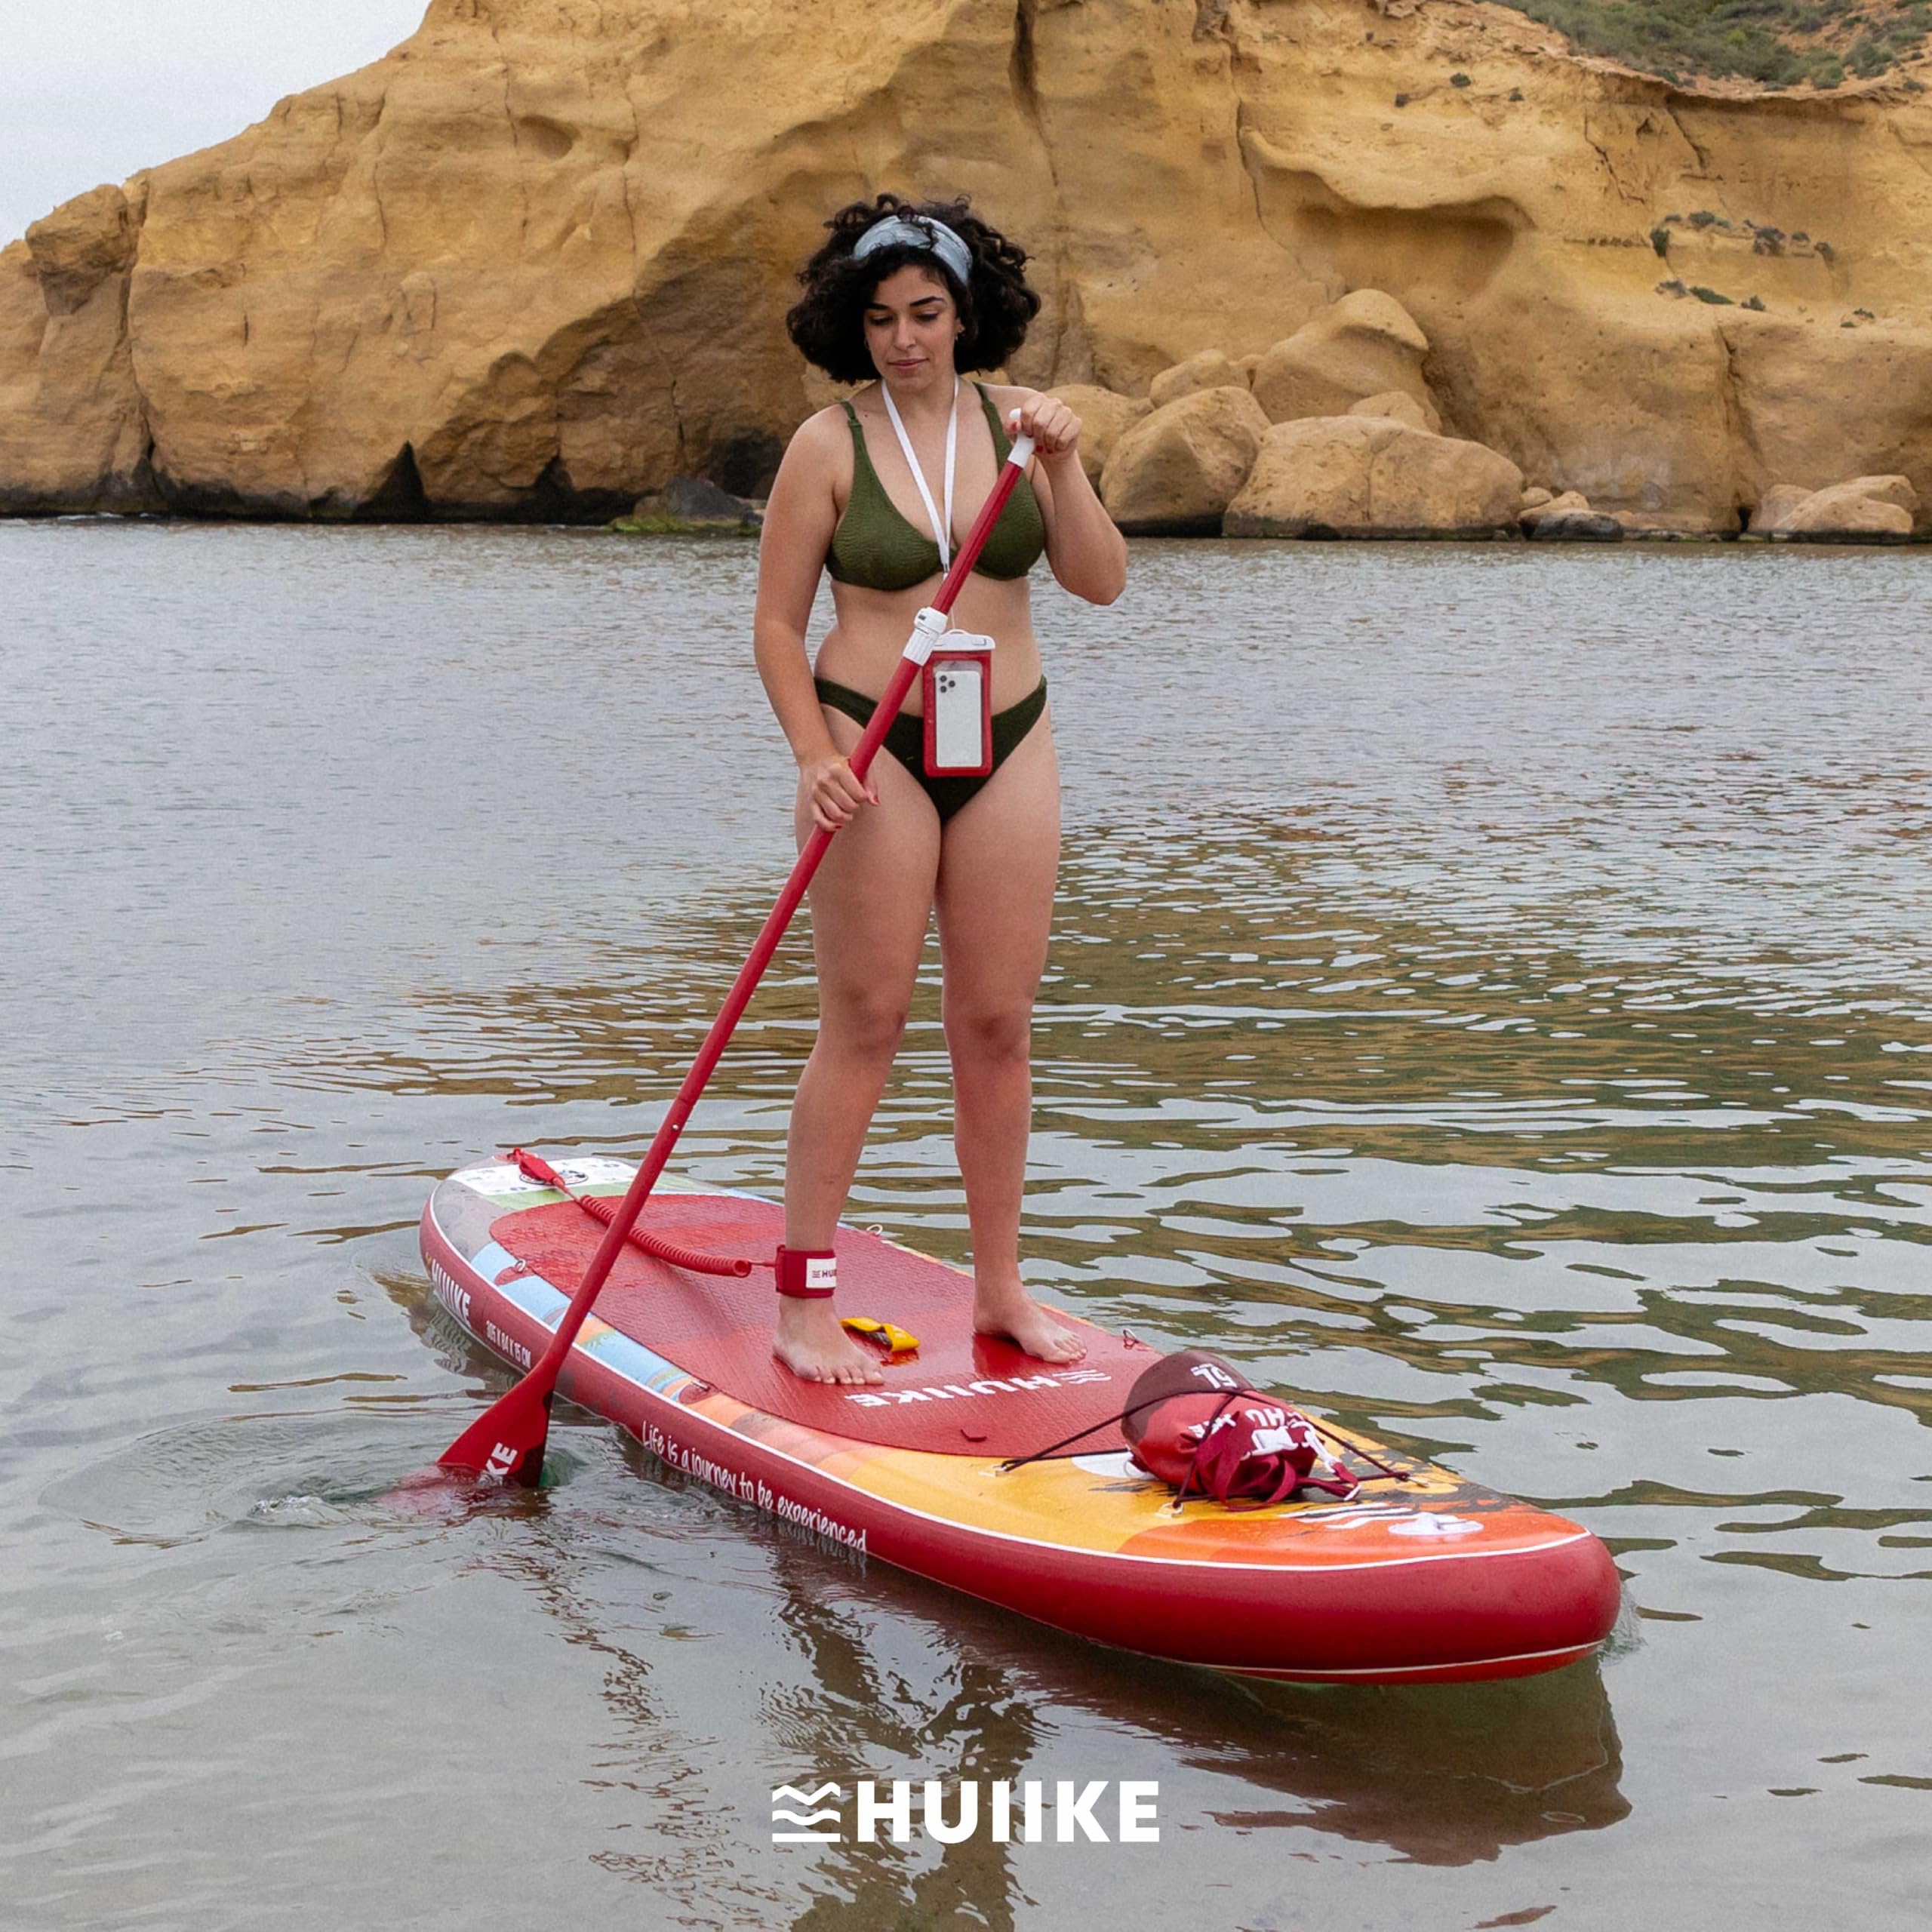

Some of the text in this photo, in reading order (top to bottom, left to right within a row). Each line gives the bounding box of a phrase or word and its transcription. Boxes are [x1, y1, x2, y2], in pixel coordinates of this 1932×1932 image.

[844, 1375, 1061, 1407] HUIIKE
[642, 1420, 867, 1552] Life is a journey to be experienced
